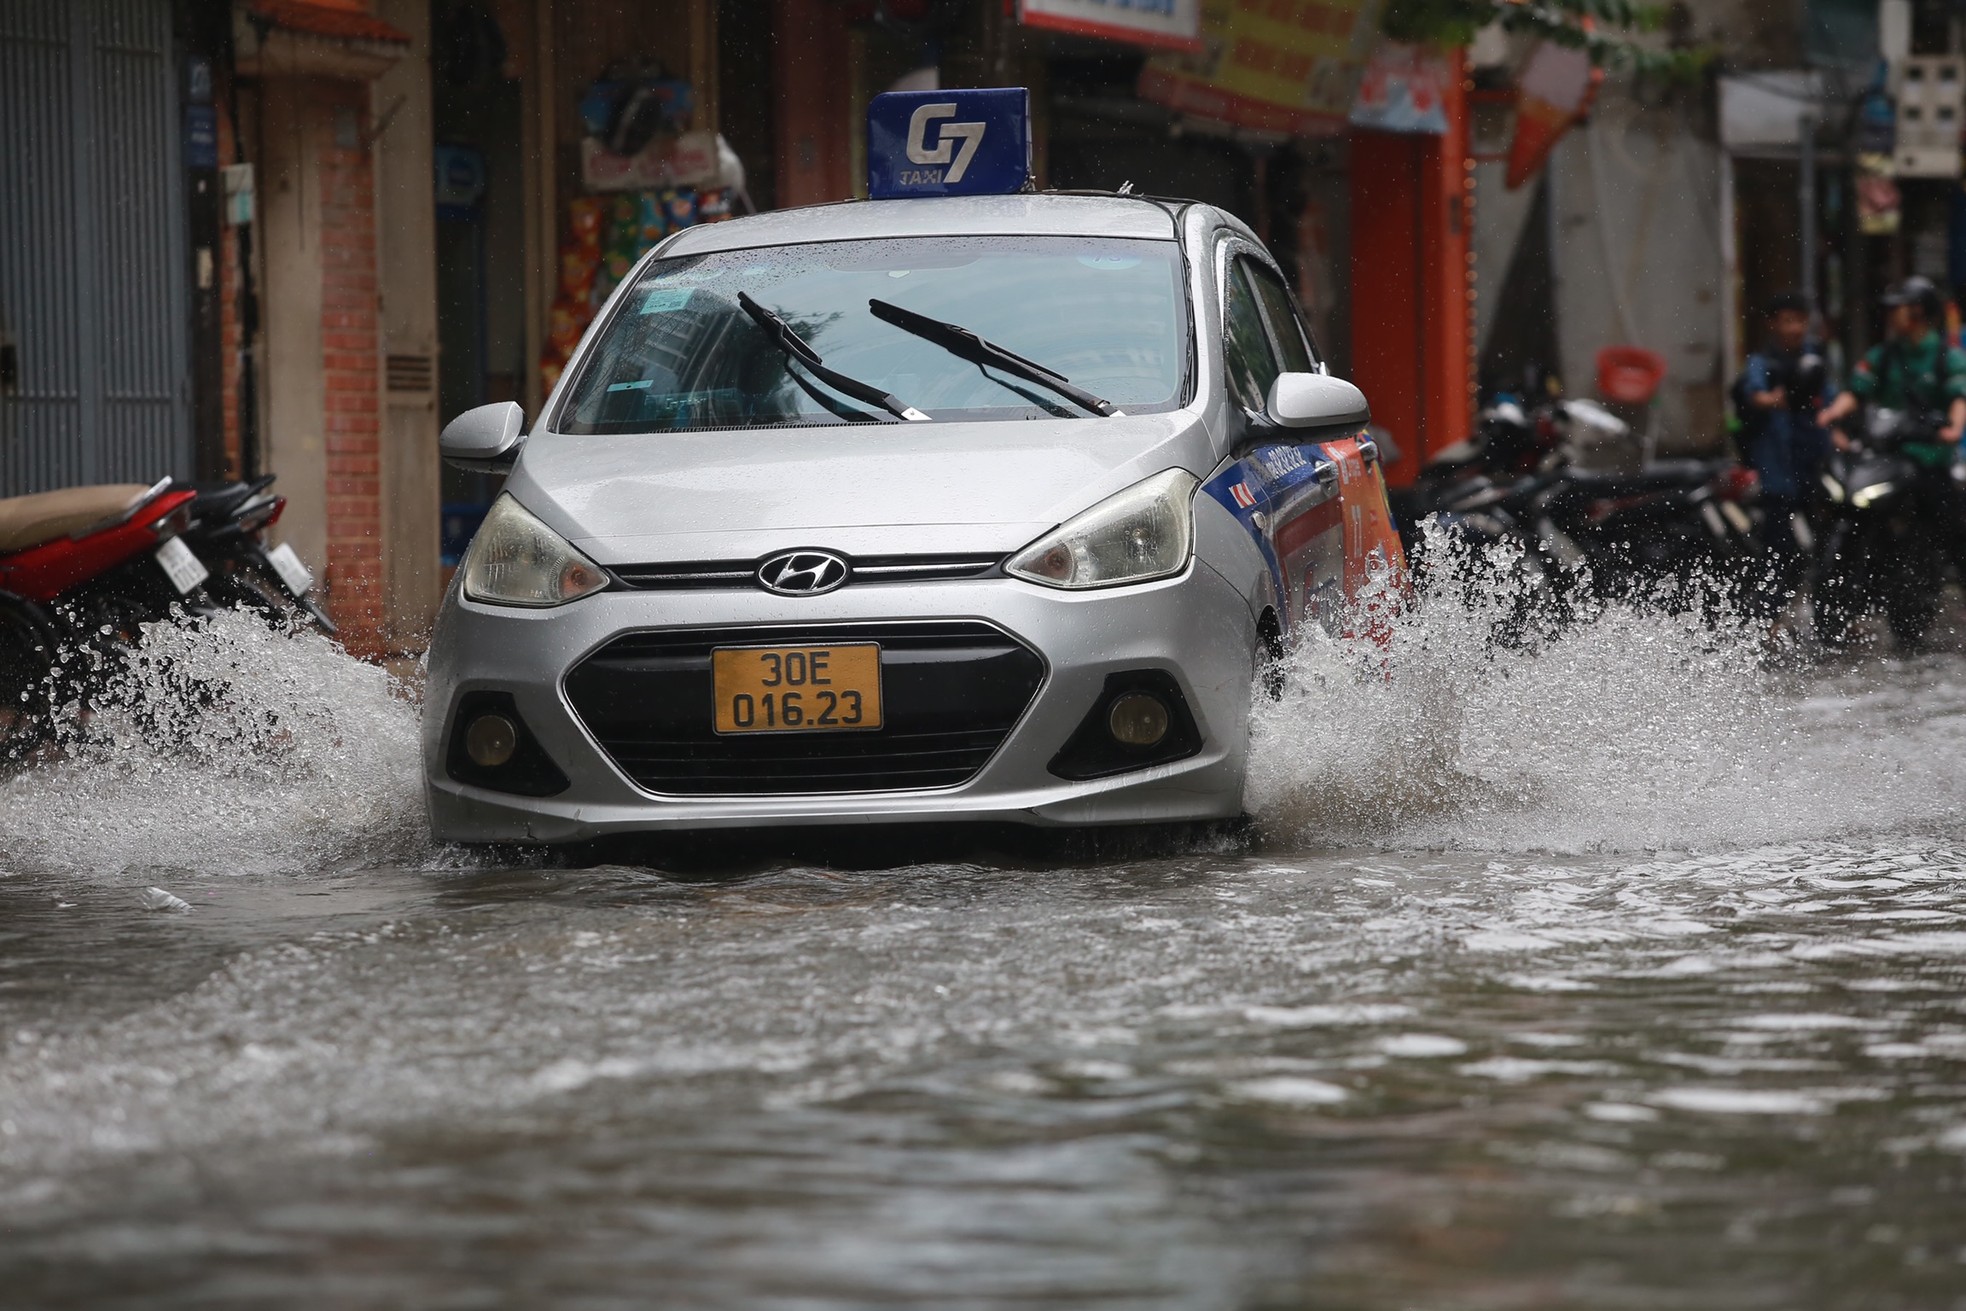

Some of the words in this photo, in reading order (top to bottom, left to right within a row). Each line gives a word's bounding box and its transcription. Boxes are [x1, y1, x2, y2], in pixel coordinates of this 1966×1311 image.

[906, 102, 986, 183] G7
[900, 168, 942, 185] TAXI
[760, 651, 831, 687] 30E
[733, 690, 862, 728] 016.23
